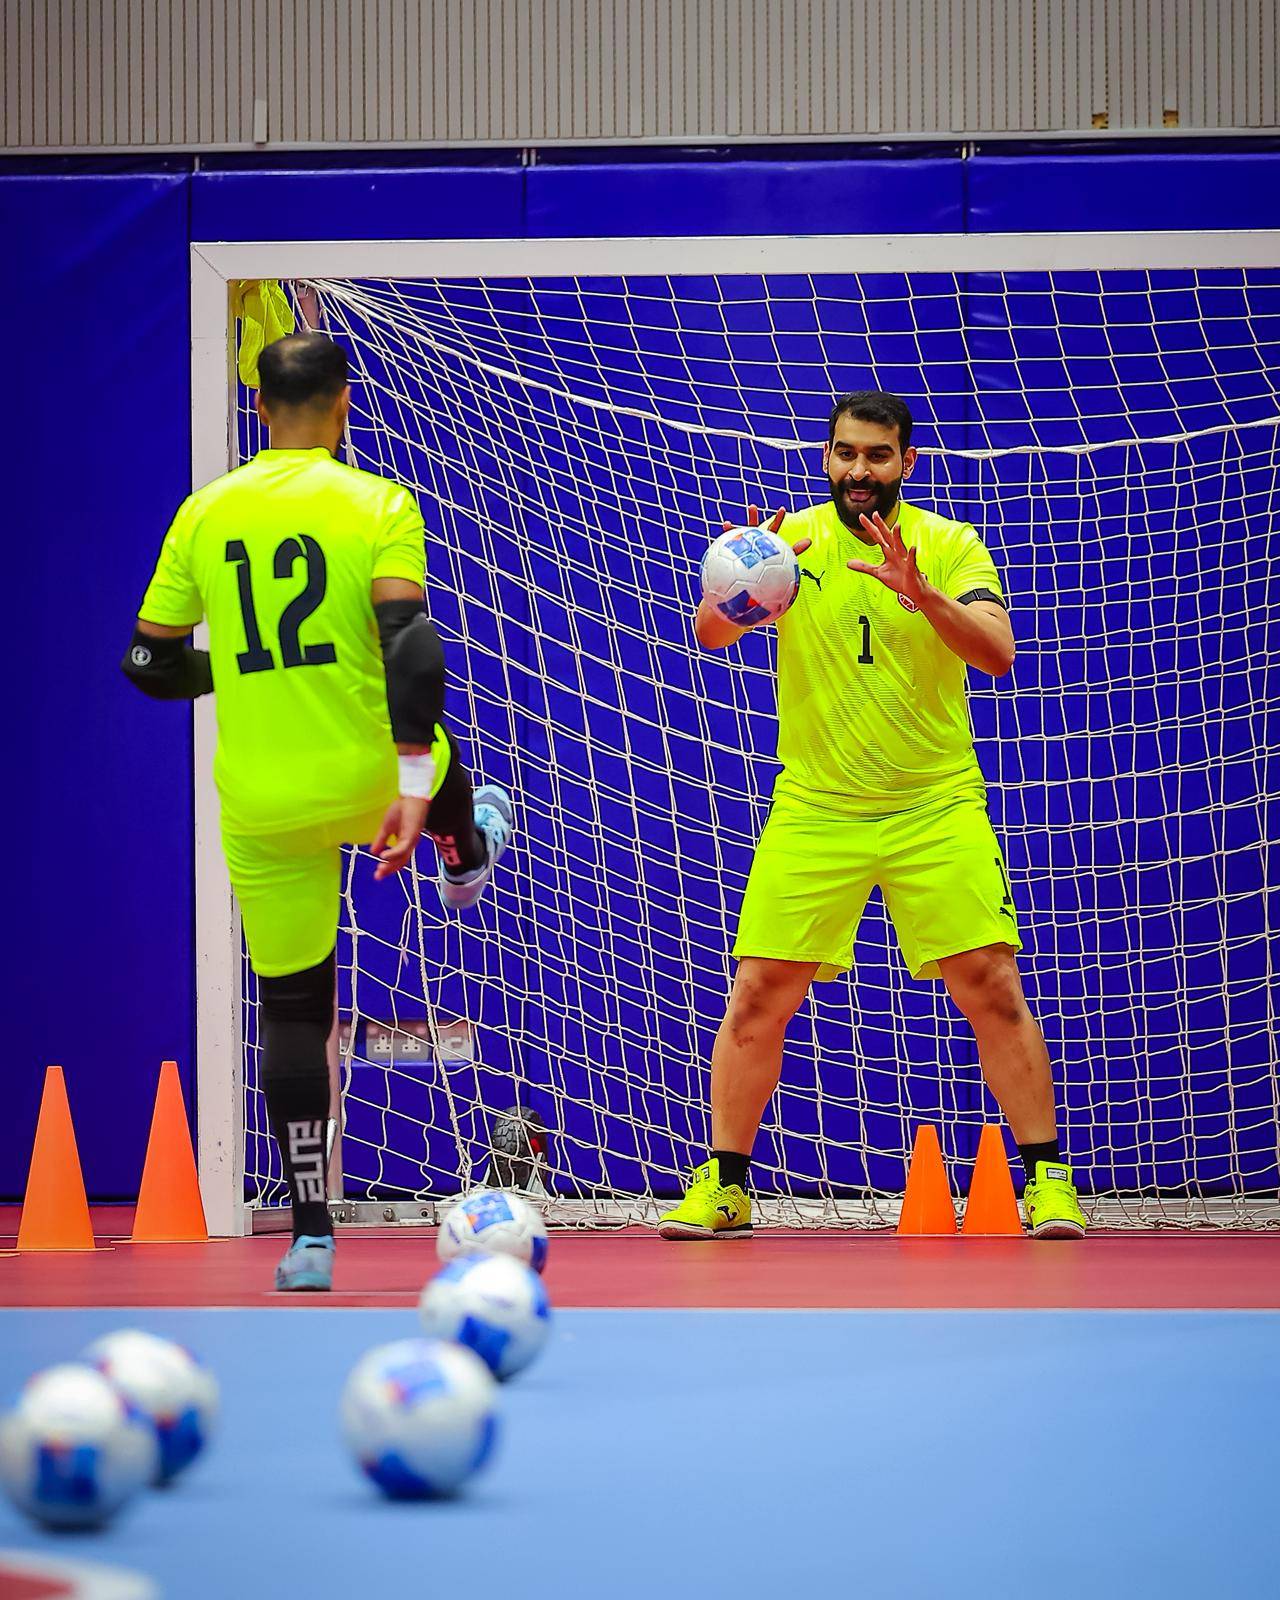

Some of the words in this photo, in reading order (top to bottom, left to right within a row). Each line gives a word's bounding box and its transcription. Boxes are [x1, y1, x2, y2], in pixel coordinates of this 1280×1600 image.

[225, 533, 337, 675] 12
[858, 615, 874, 664] 1
[994, 857, 1012, 905] 1
